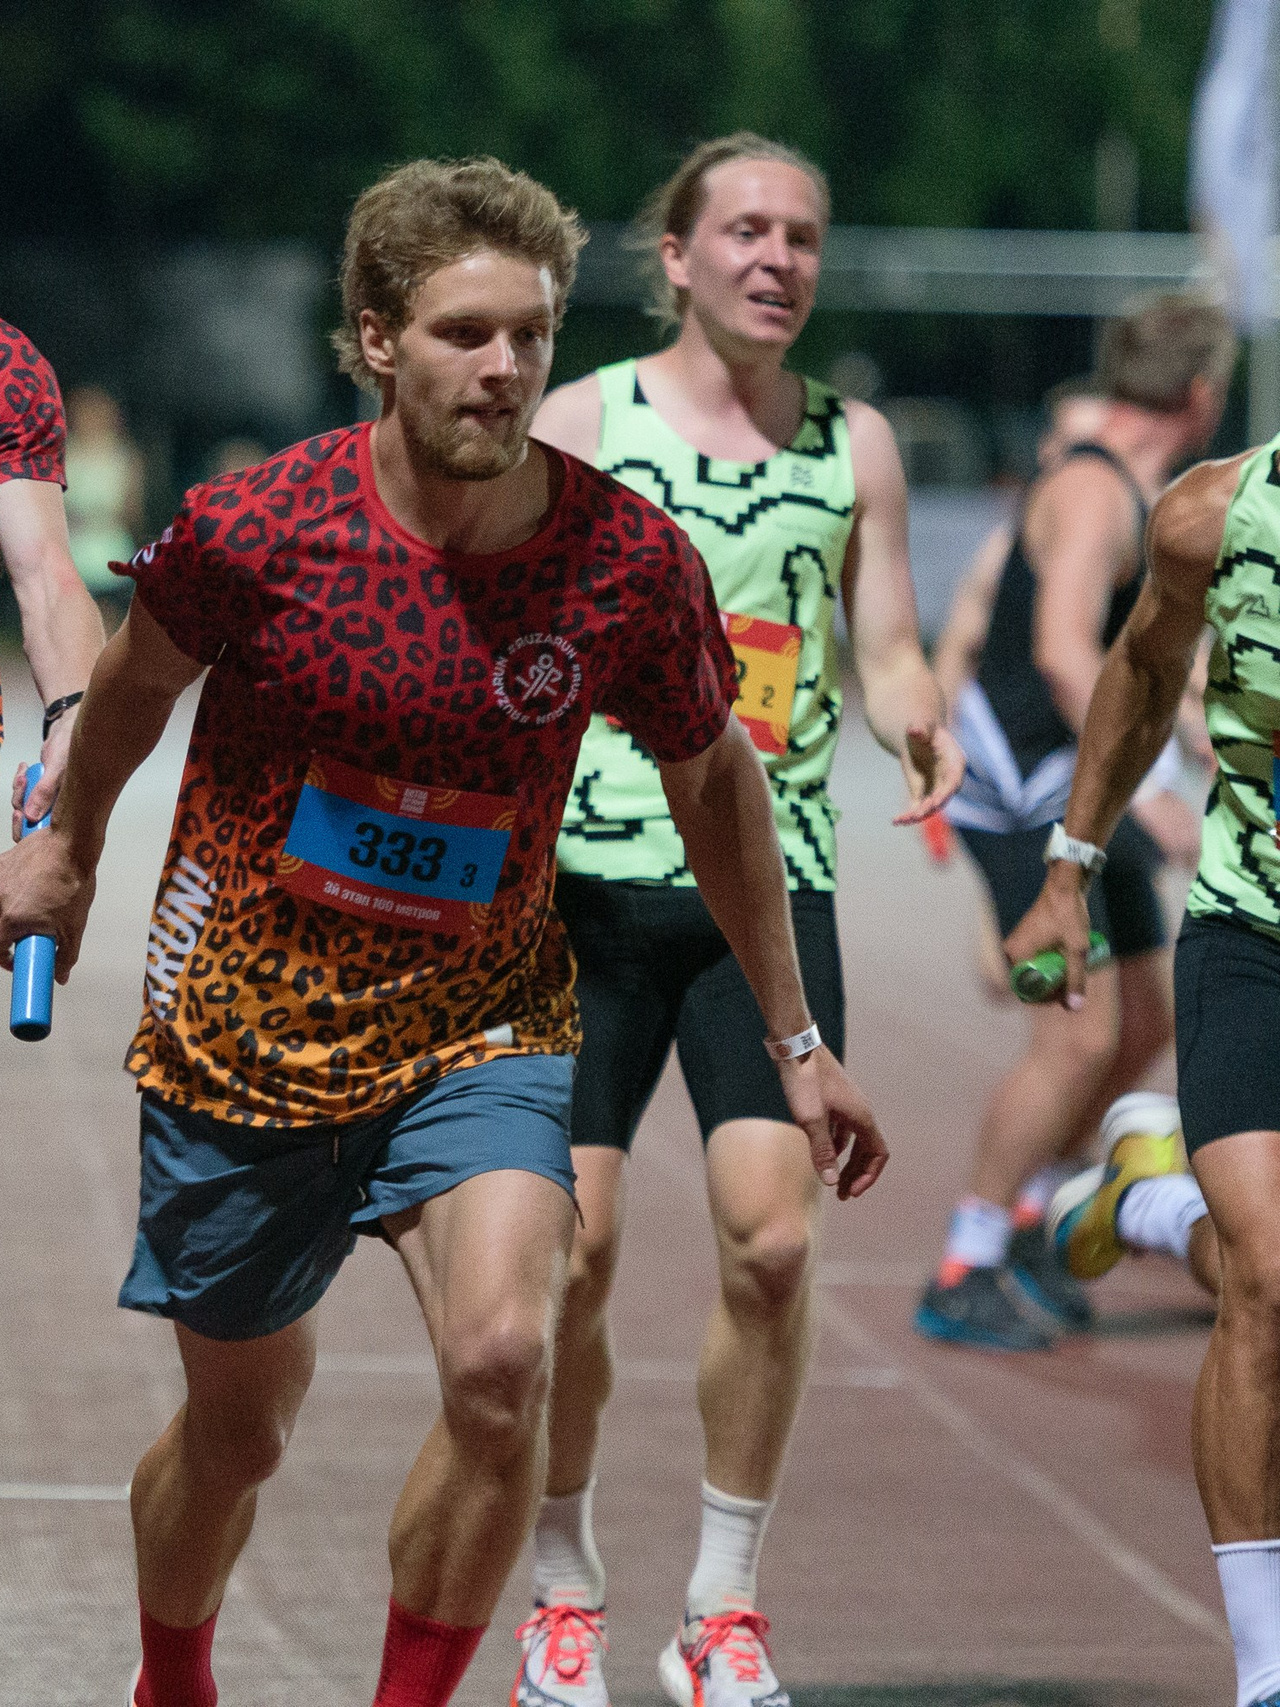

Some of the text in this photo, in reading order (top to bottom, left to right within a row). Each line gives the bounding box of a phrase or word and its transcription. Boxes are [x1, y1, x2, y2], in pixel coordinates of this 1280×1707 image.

[761, 685, 775, 708] 2
[349, 821, 478, 888] 333 3
[341, 889, 371, 906] этап
[372, 897, 395, 912] 100
[395, 904, 441, 921] метров
